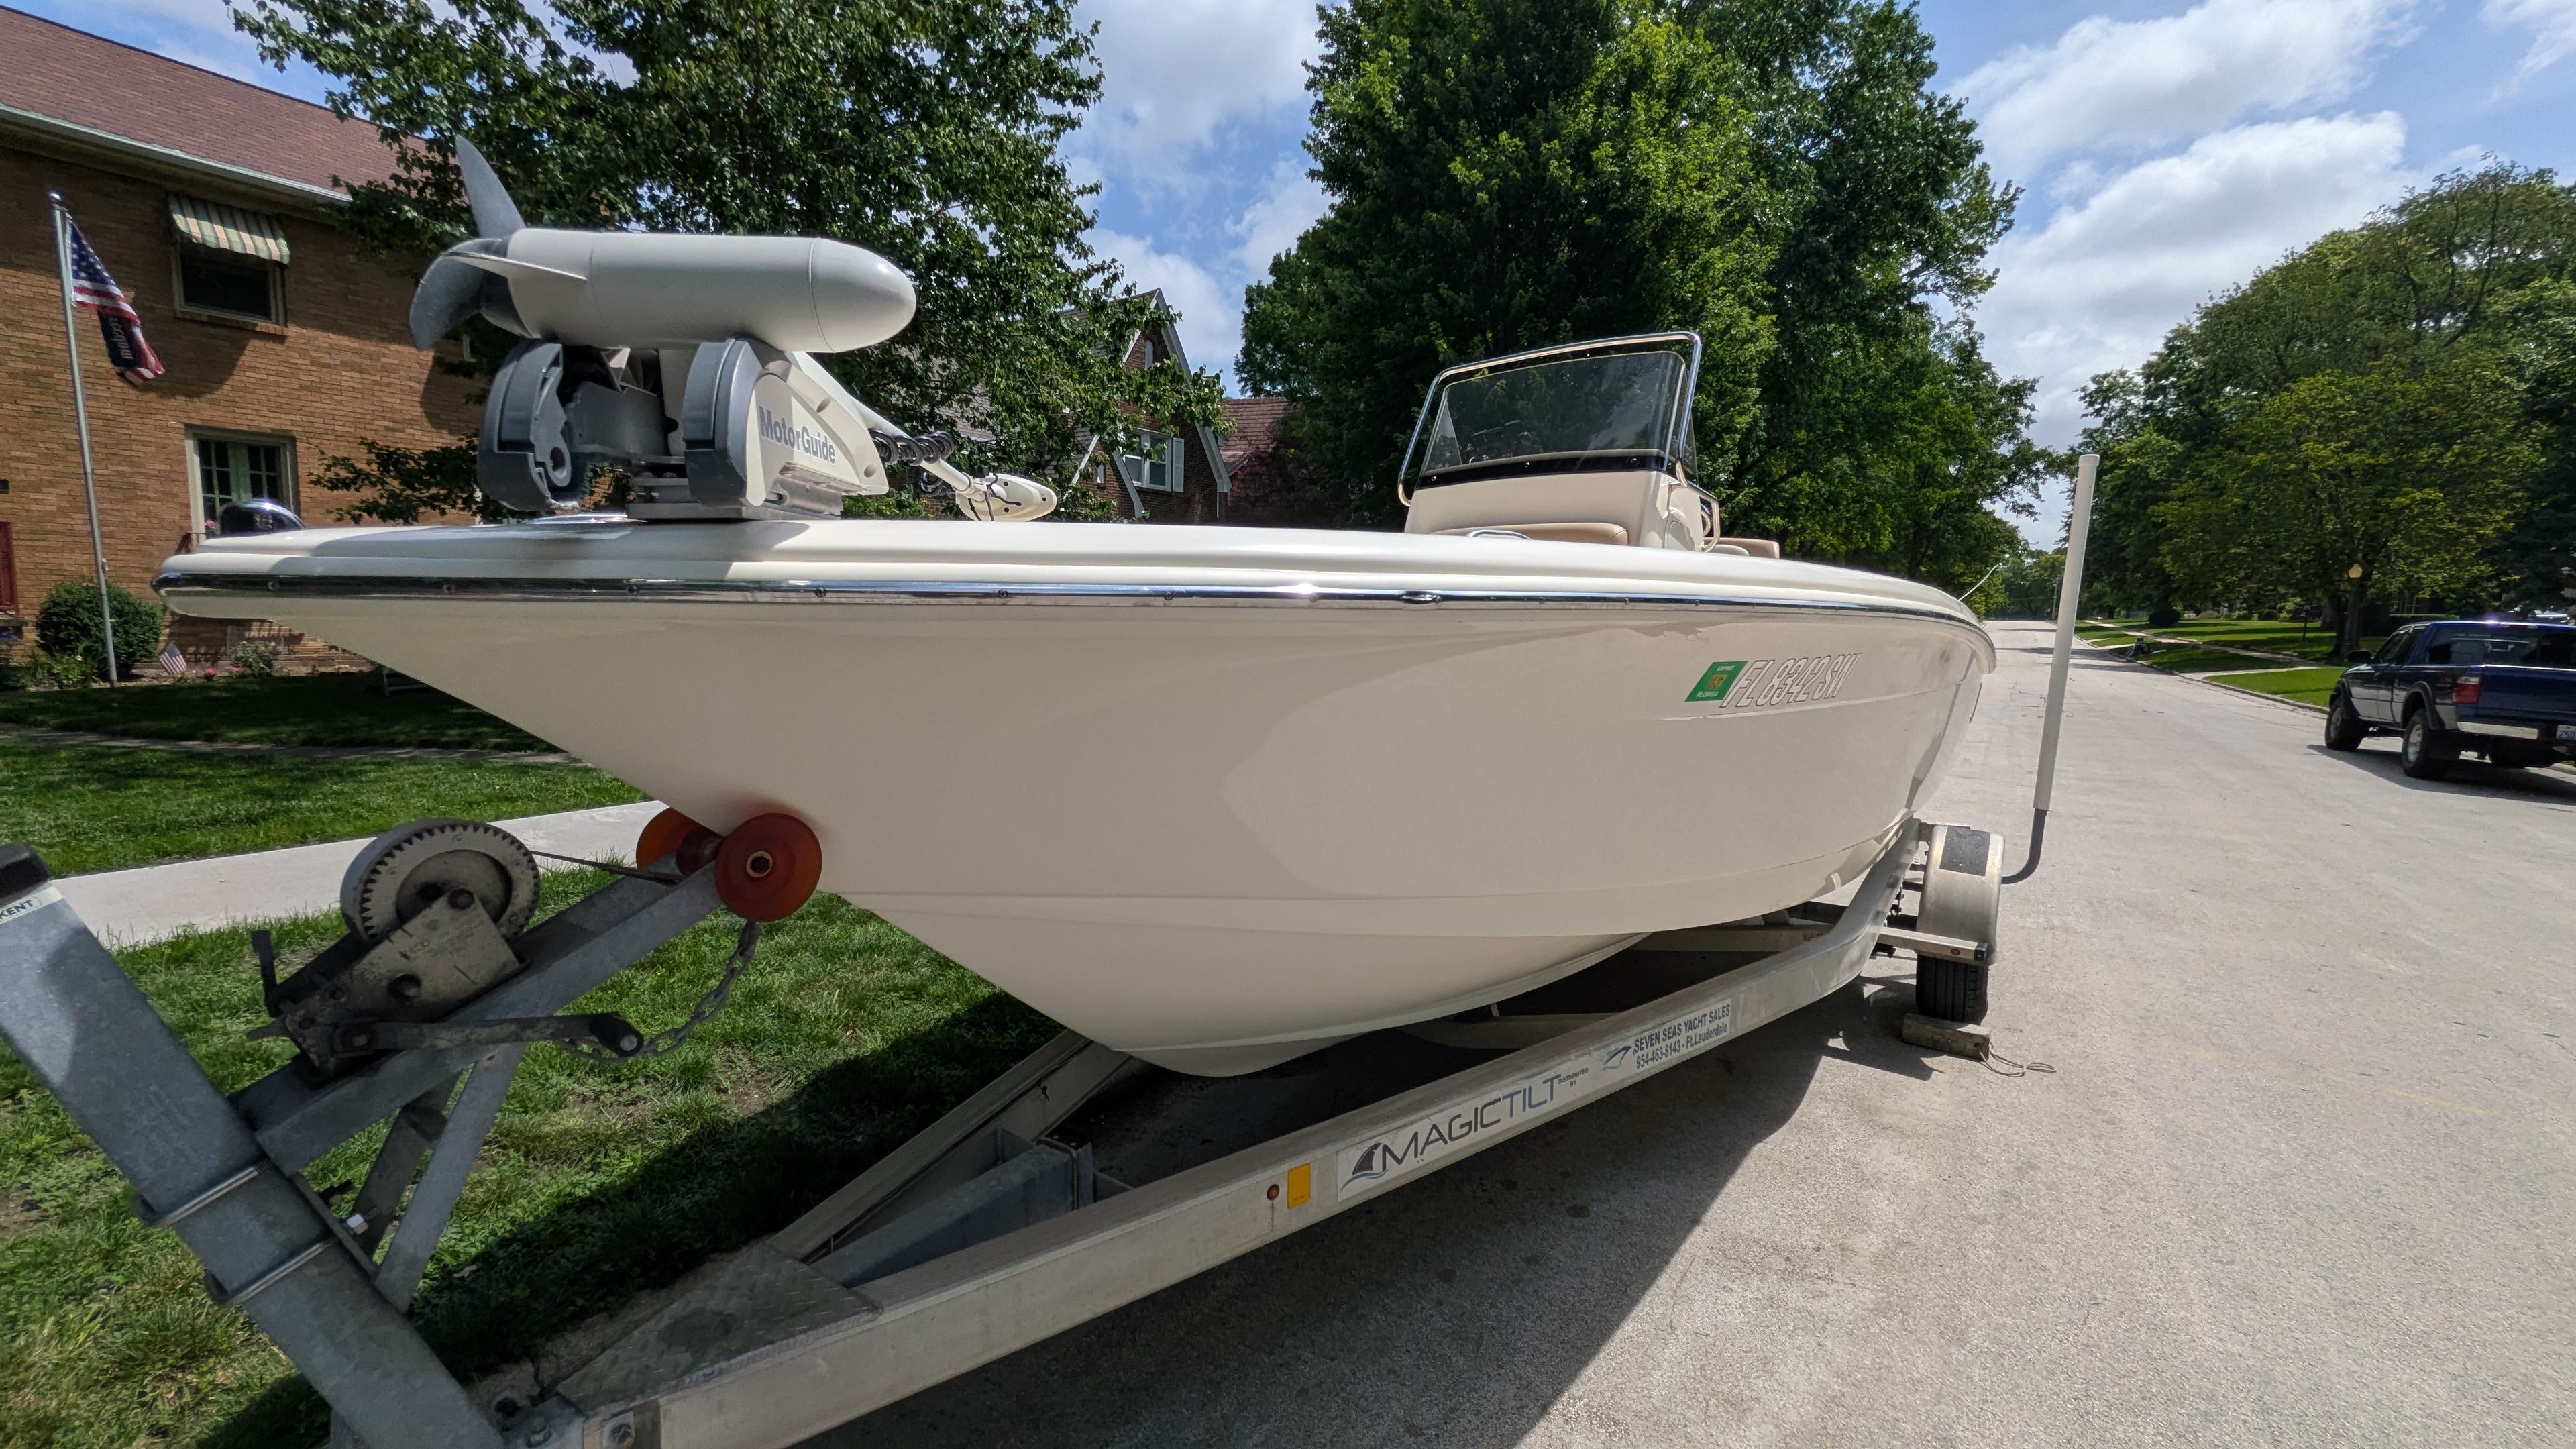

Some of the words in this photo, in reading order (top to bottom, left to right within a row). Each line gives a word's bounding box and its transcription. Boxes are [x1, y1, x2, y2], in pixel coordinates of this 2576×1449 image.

[759, 405, 837, 464] MotorGuide
[1719, 660, 1776, 708] FL
[1755, 654, 1827, 706] 8342
[1633, 1032, 1660, 1053] SEVEN
[1662, 1022, 1682, 1042] SEAS
[1684, 1013, 1707, 1034] YACHT
[1709, 1004, 1730, 1024] SALES
[1635, 1039, 1681, 1069] 954-463-8143
[1558, 1067, 1589, 1085] DISTRIBUTED
[1381, 1073, 1562, 1172] MAGICTILT
